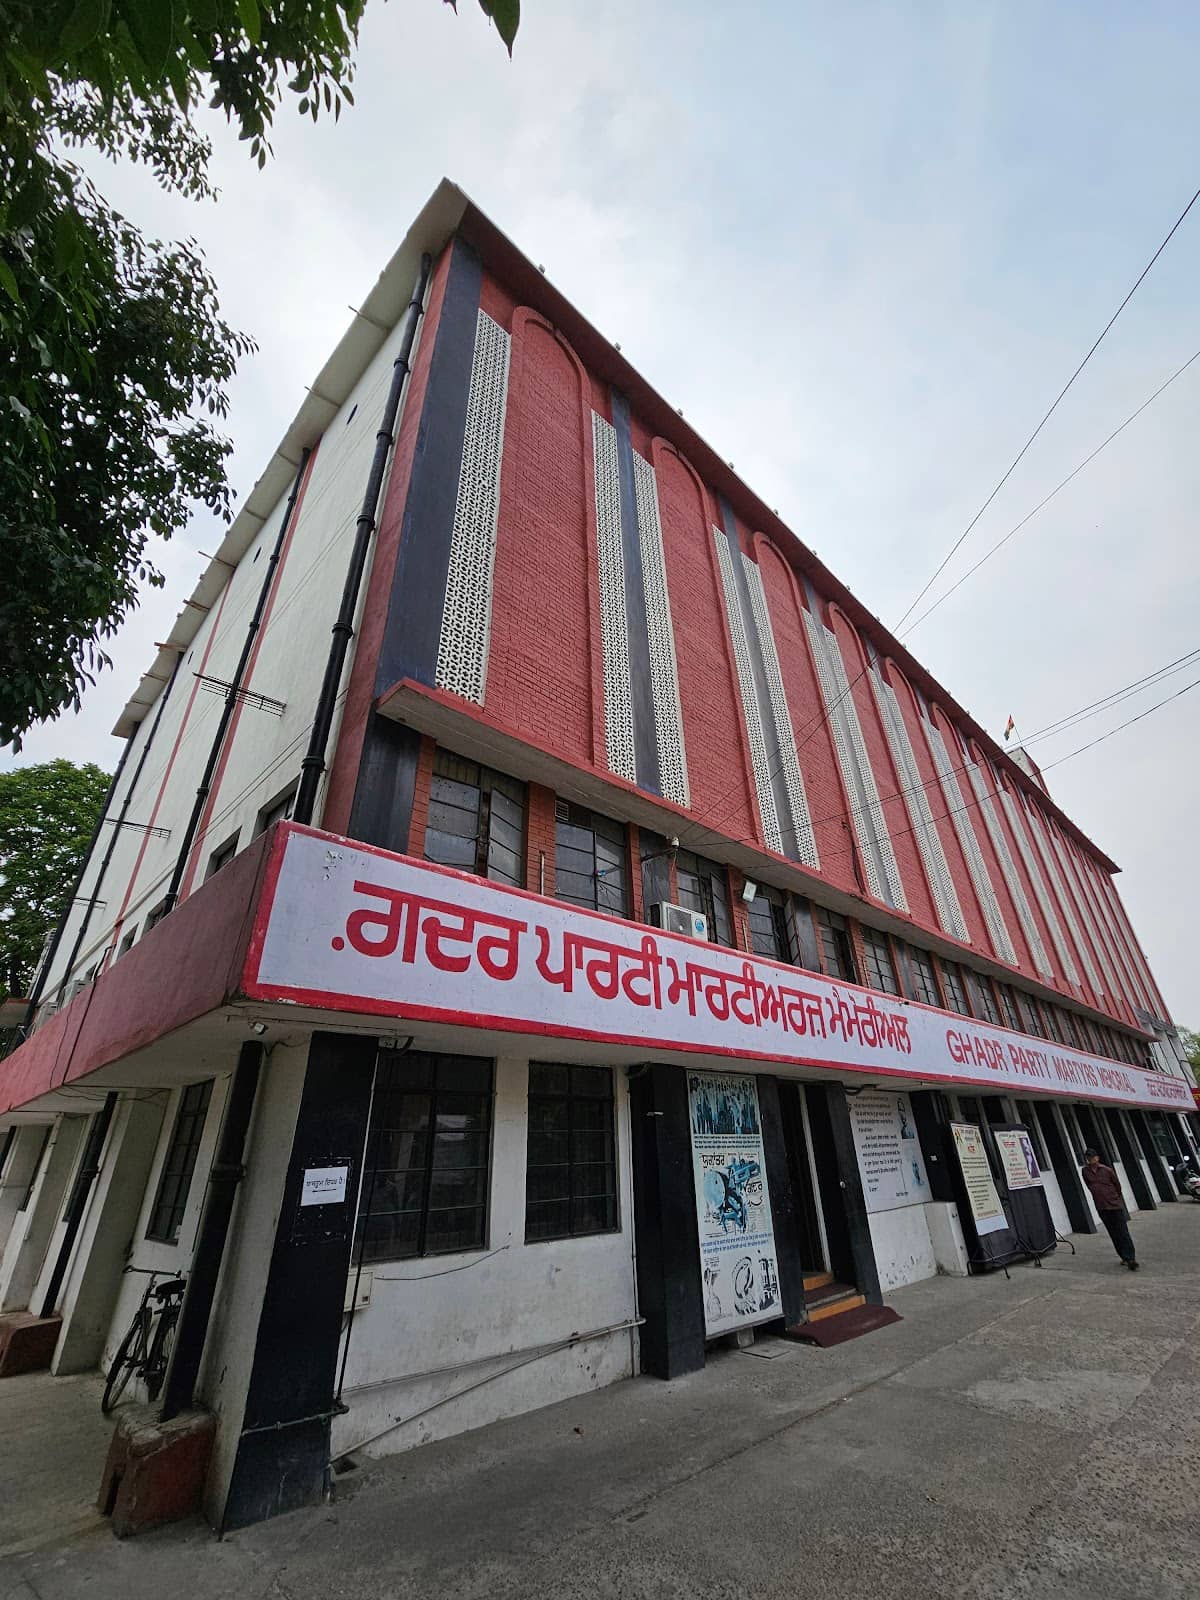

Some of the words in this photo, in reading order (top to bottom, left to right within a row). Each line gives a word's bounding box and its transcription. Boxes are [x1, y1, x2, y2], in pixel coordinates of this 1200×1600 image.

[535, 924, 662, 1010] ਪਾਰਟੀ
[946, 1030, 1009, 1072] GHADR
[1007, 1043, 1052, 1079] PARTY
[1052, 1055, 1098, 1087] MARTYRS
